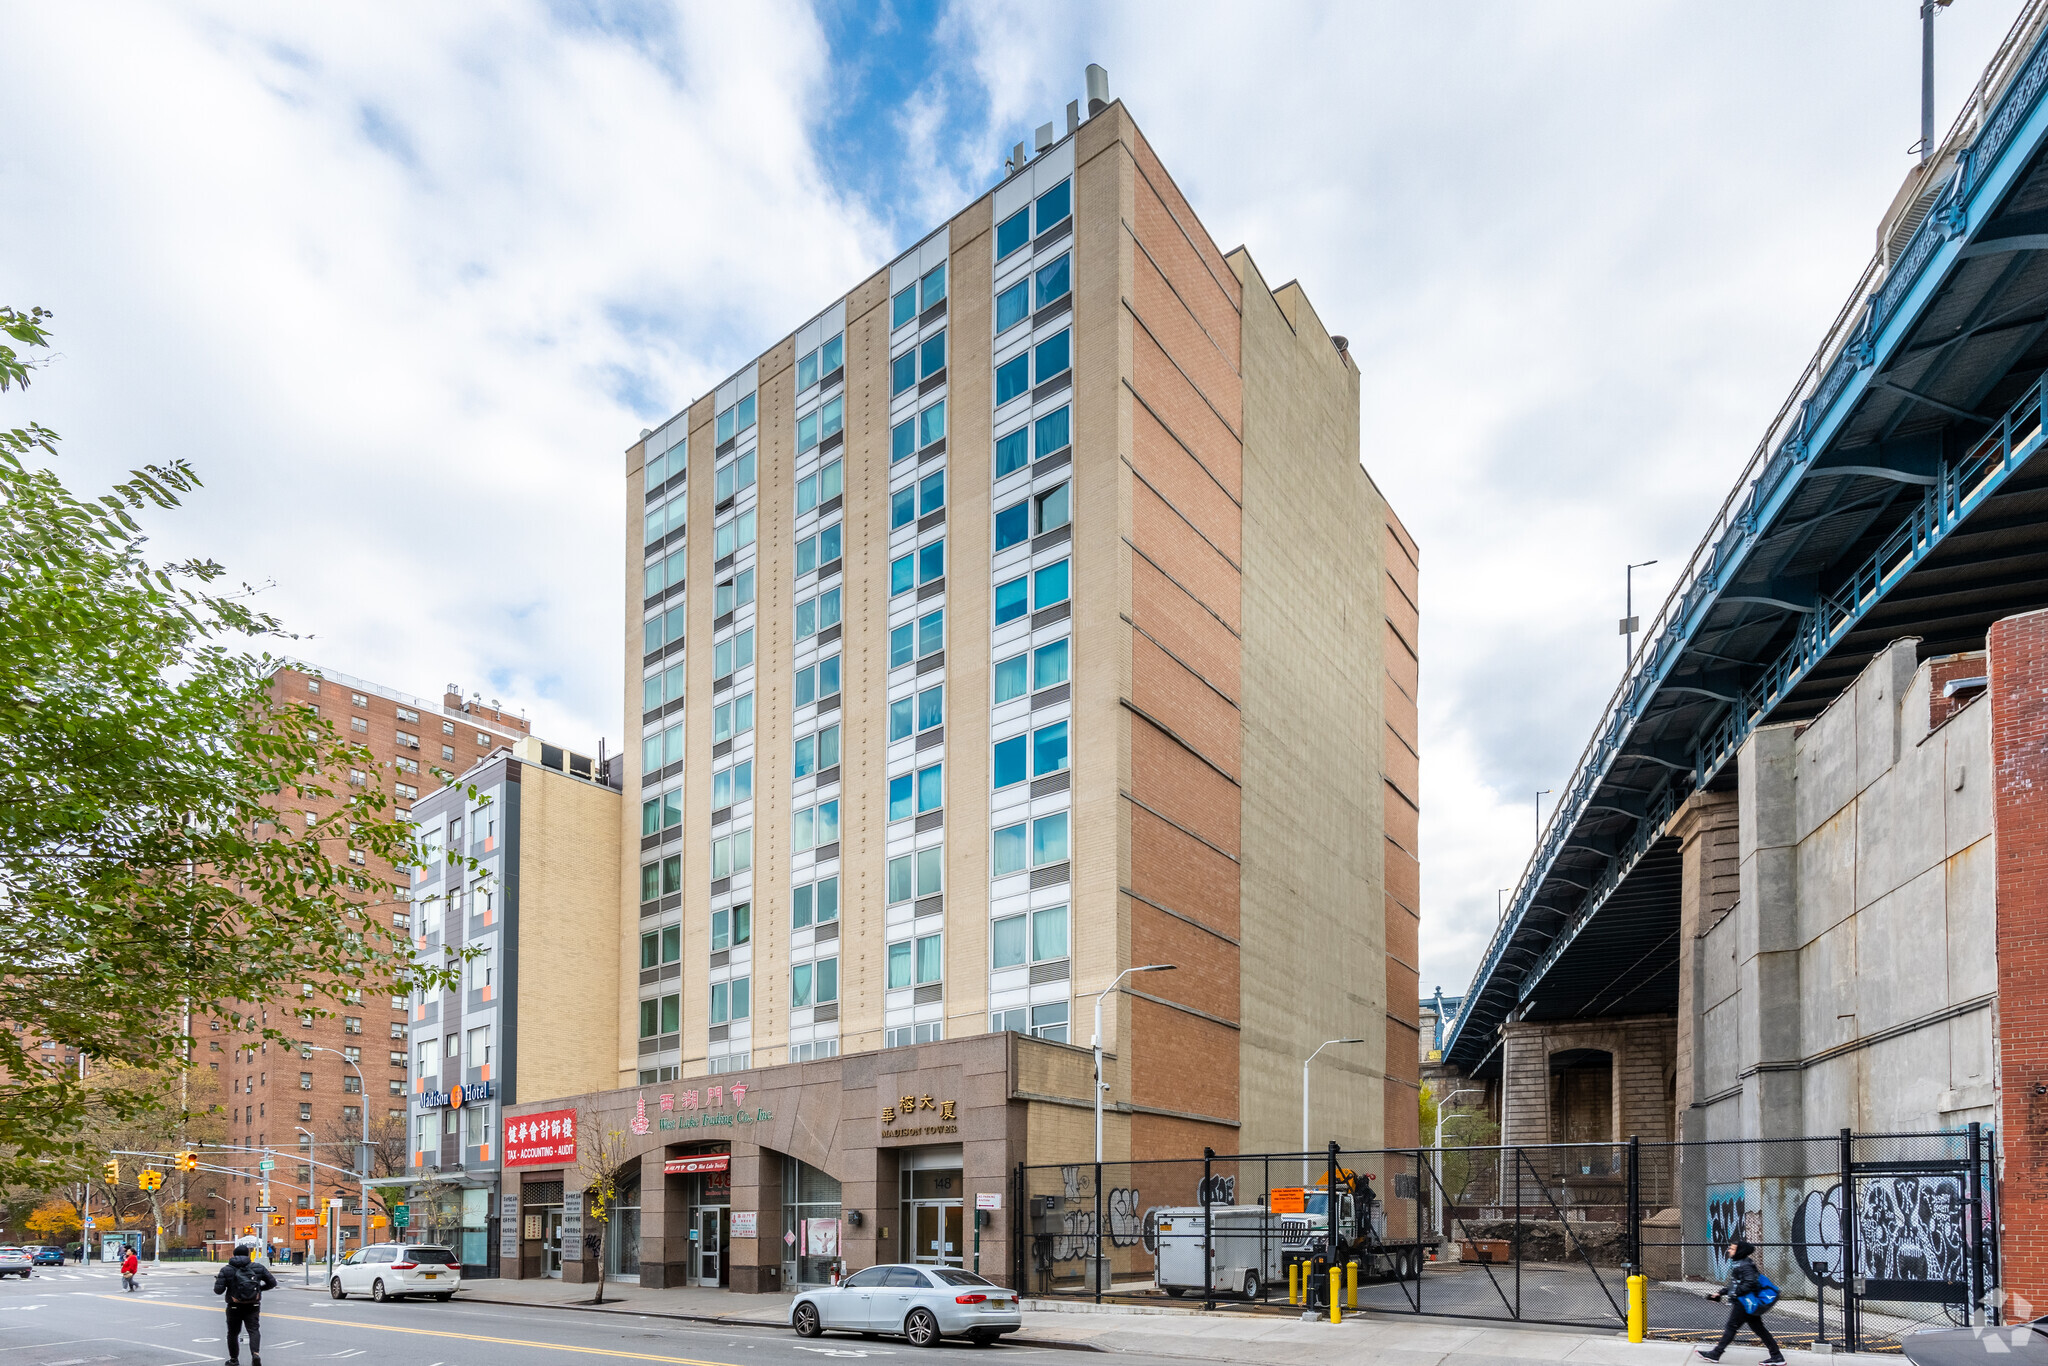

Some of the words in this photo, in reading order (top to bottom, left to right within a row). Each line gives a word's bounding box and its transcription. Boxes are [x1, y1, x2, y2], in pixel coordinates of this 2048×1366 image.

[420, 1091, 449, 1108] Madison
[465, 1081, 488, 1101] Hotel
[660, 1081, 749, 1112] 西湖門市
[660, 1118, 676, 1131] West
[679, 1116, 699, 1129] Lake
[702, 1111, 733, 1127] Trading
[757, 1107, 774, 1121] Inc.
[881, 1093, 957, 1126] 華榕大廈
[881, 1127, 922, 1138] MADISON
[924, 1125, 958, 1135] TOWER
[507, 1150, 517, 1160] TAX
[520, 1146, 553, 1159] ACCOUNTING
[557, 1144, 574, 1155] AUDIT
[934, 1177, 952, 1190] 148
